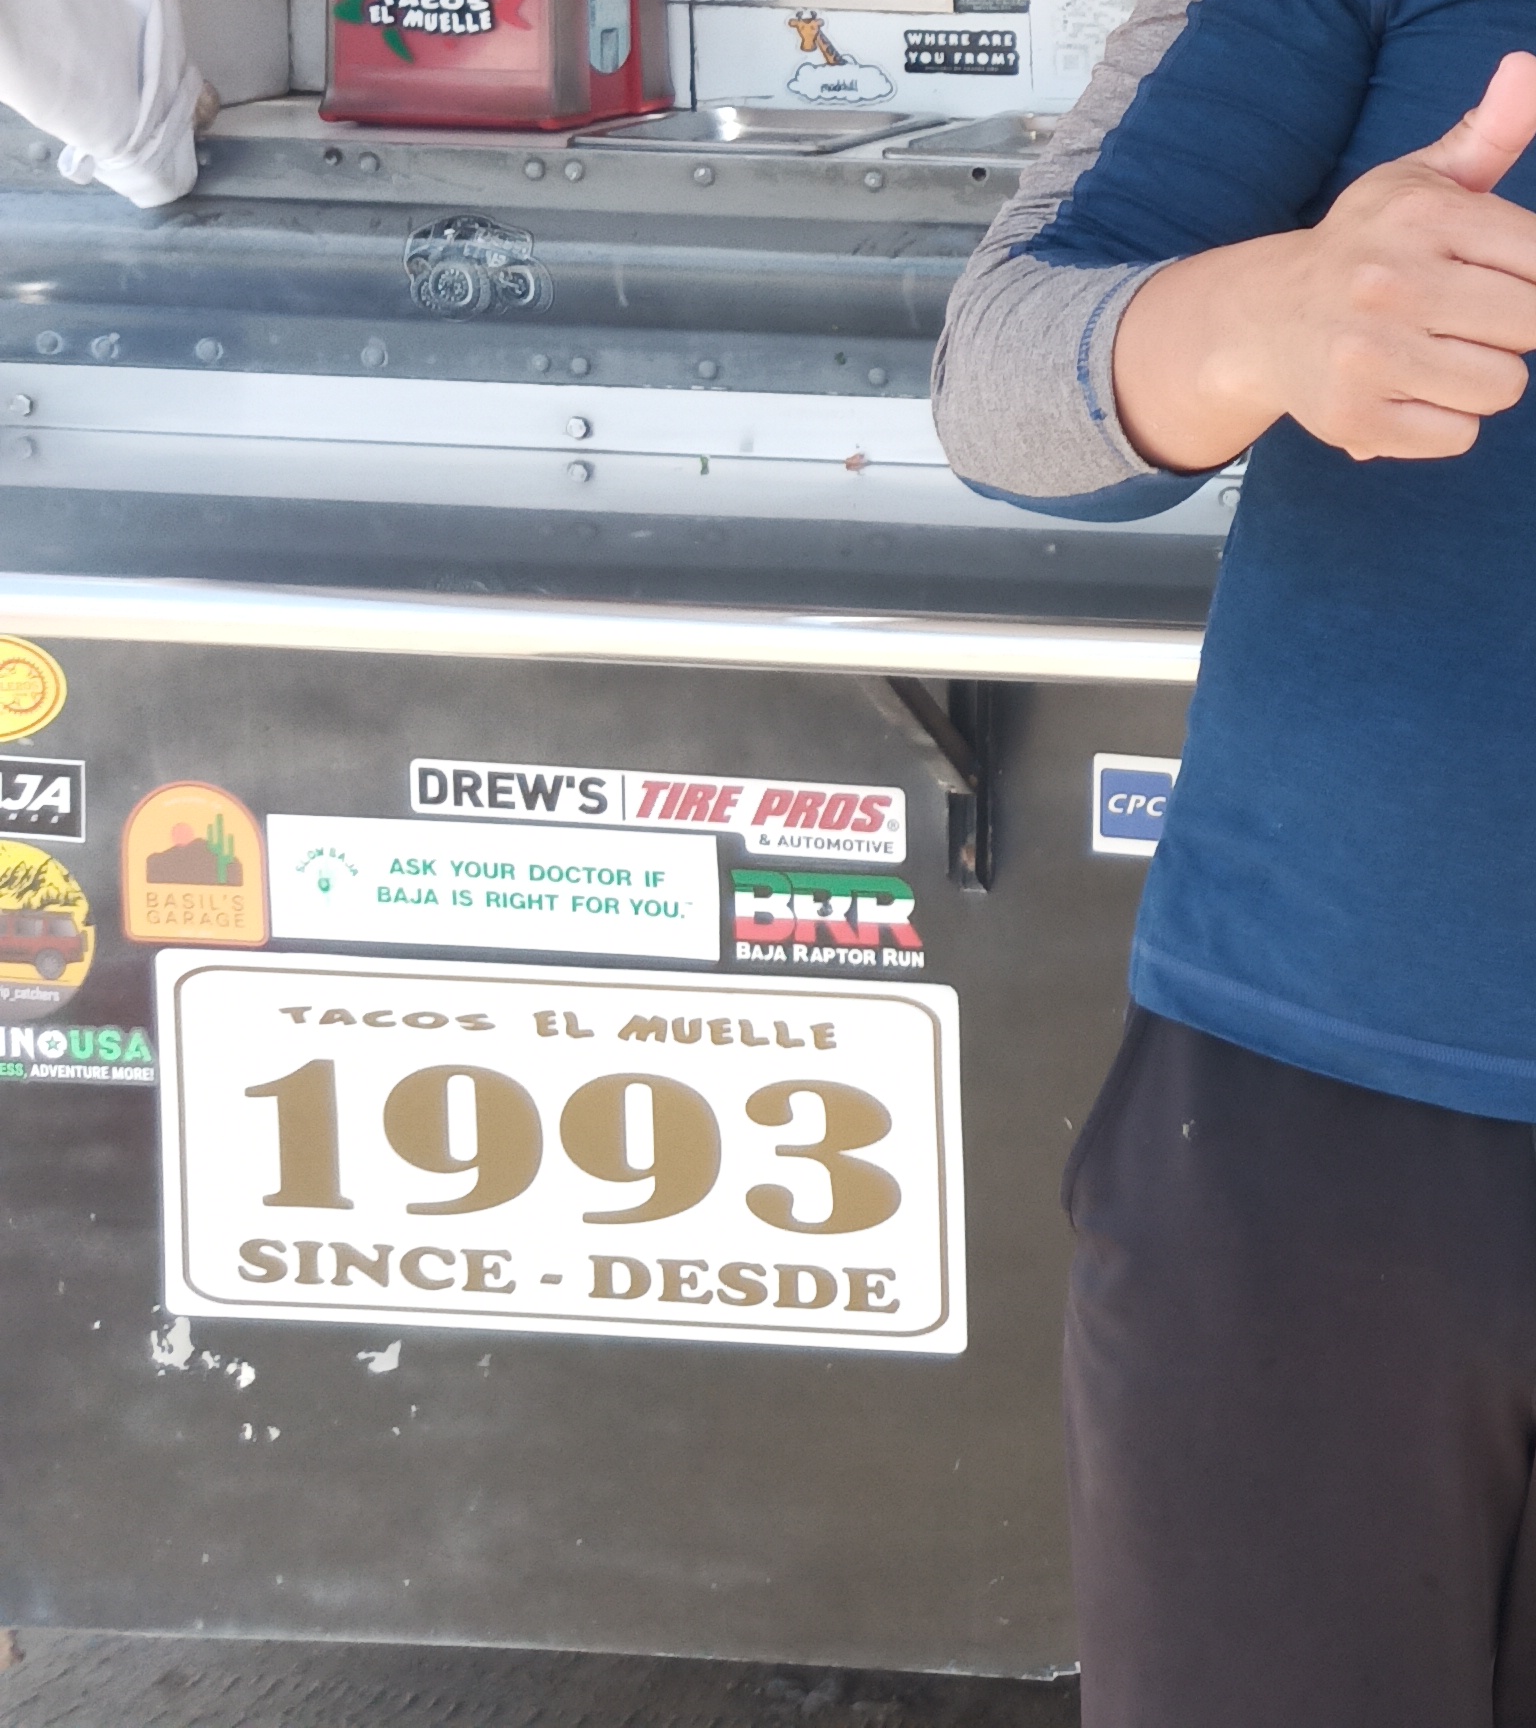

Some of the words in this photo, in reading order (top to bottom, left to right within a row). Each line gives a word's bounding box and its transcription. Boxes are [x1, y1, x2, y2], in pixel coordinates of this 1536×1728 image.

[369, 5, 396, 25] EL
[403, 7, 494, 35] MUELLE
[907, 32, 971, 48] WHERE
[978, 32, 1014, 47] ARE
[907, 51, 945, 67] YOU
[953, 51, 1016, 67] FROM?
[416, 766, 609, 816] DREW'S
[634, 779, 747, 826] TIRE
[749, 787, 894, 833] PROS
[1107, 792, 1168, 818] CPC
[758, 833, 772, 848] &
[776, 834, 895, 855] AUTOMOTIVE
[388, 857, 437, 878] ASK
[449, 858, 517, 883] YOUR
[527, 863, 633, 888] DOCTOR
[644, 869, 667, 889] IF
[145, 892, 245, 913] BASIL'S
[376, 884, 440, 908] BAJA
[451, 888, 475, 909] IS
[484, 890, 560, 913] RIGHT
[570, 895, 621, 916] FOR
[729, 868, 924, 950] BRR
[145, 909, 246, 930] GARAGE
[735, 942, 789, 963] BAJA
[791, 943, 878, 969] RAPTOR
[881, 946, 926, 969] RUN
[278, 1005, 497, 1032] TACOS
[532, 1009, 595, 1039] EL
[616, 1013, 839, 1051] MUELLE
[30, 1063, 110, 1082] ADVENTURE
[111, 1065, 156, 1082] MORE!
[243, 1057, 903, 1236] 1993
[236, 1237, 517, 1296] SINCE
[587, 1254, 902, 1315] DESDE
